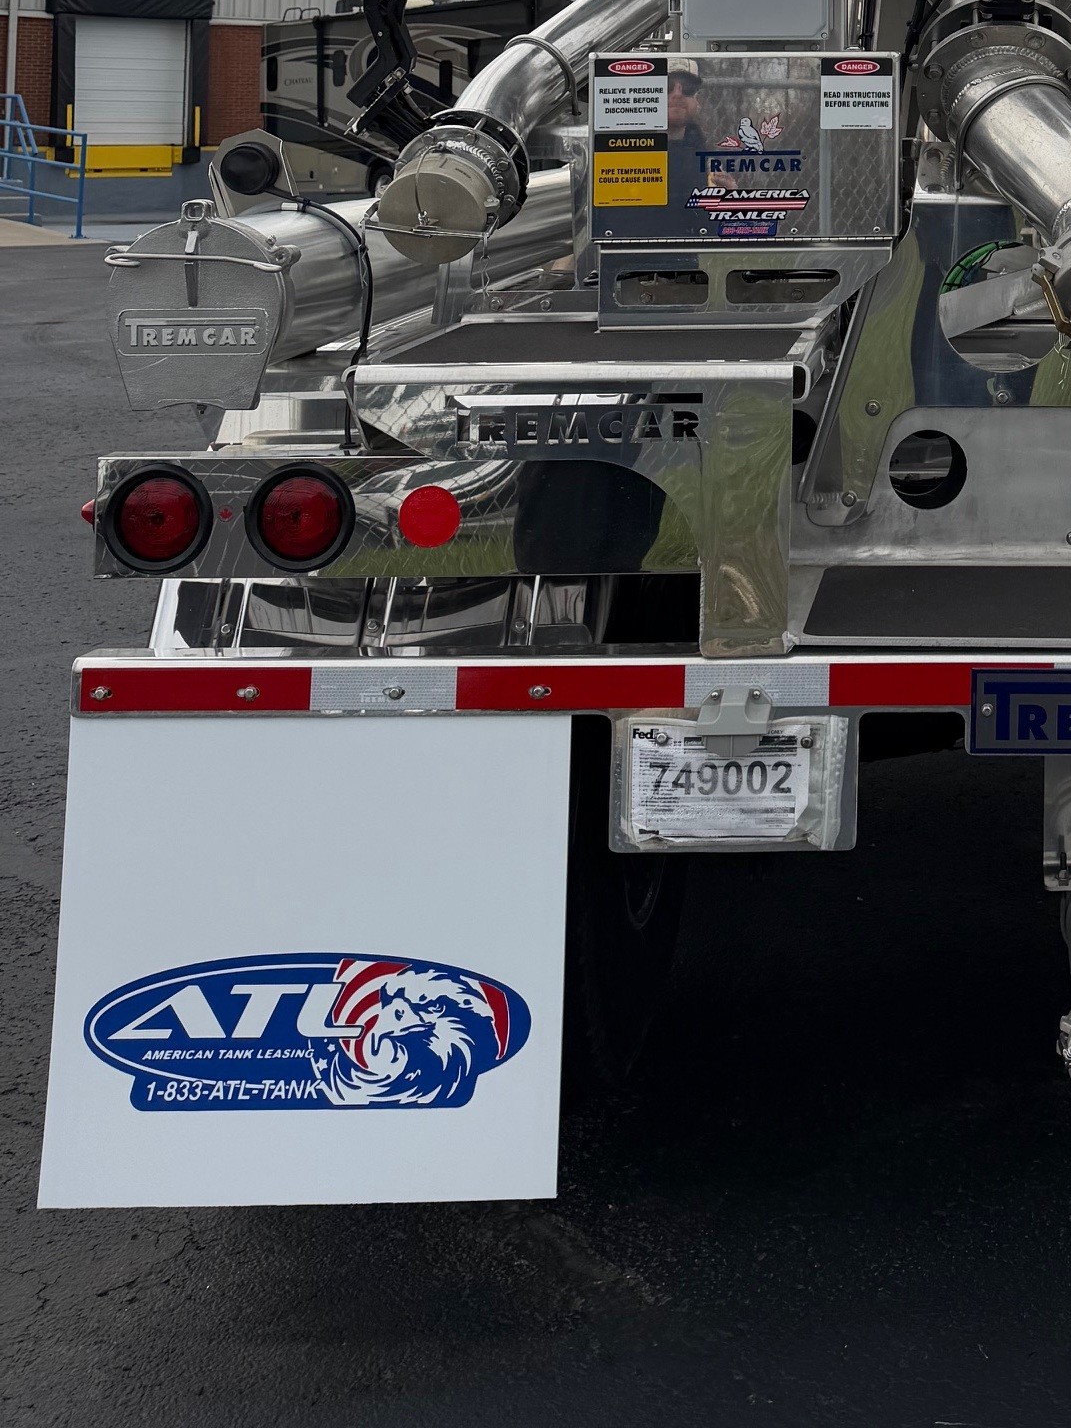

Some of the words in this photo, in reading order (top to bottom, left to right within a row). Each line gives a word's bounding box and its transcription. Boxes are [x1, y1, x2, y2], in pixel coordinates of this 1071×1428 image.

[842, 91, 891, 99] INSTRUCTIONS
[825, 100, 851, 108] BEFORE
[852, 100, 889, 108] OPERATING
[608, 138, 655, 147] CAUTION
[691, 187, 726, 196] MID
[725, 189, 810, 199] AMERICA
[708, 211, 787, 220] TRAILER
[125, 317, 257, 347] TREMCAR
[649, 760, 793, 796] 749002
[107, 983, 365, 1040] ATL
[142, 1049, 214, 1061] AMERICAN
[218, 1049, 253, 1059] TANK
[256, 1048, 315, 1060] LEASING
[146, 1079, 322, 1102] 1-833-ATL-TANK
